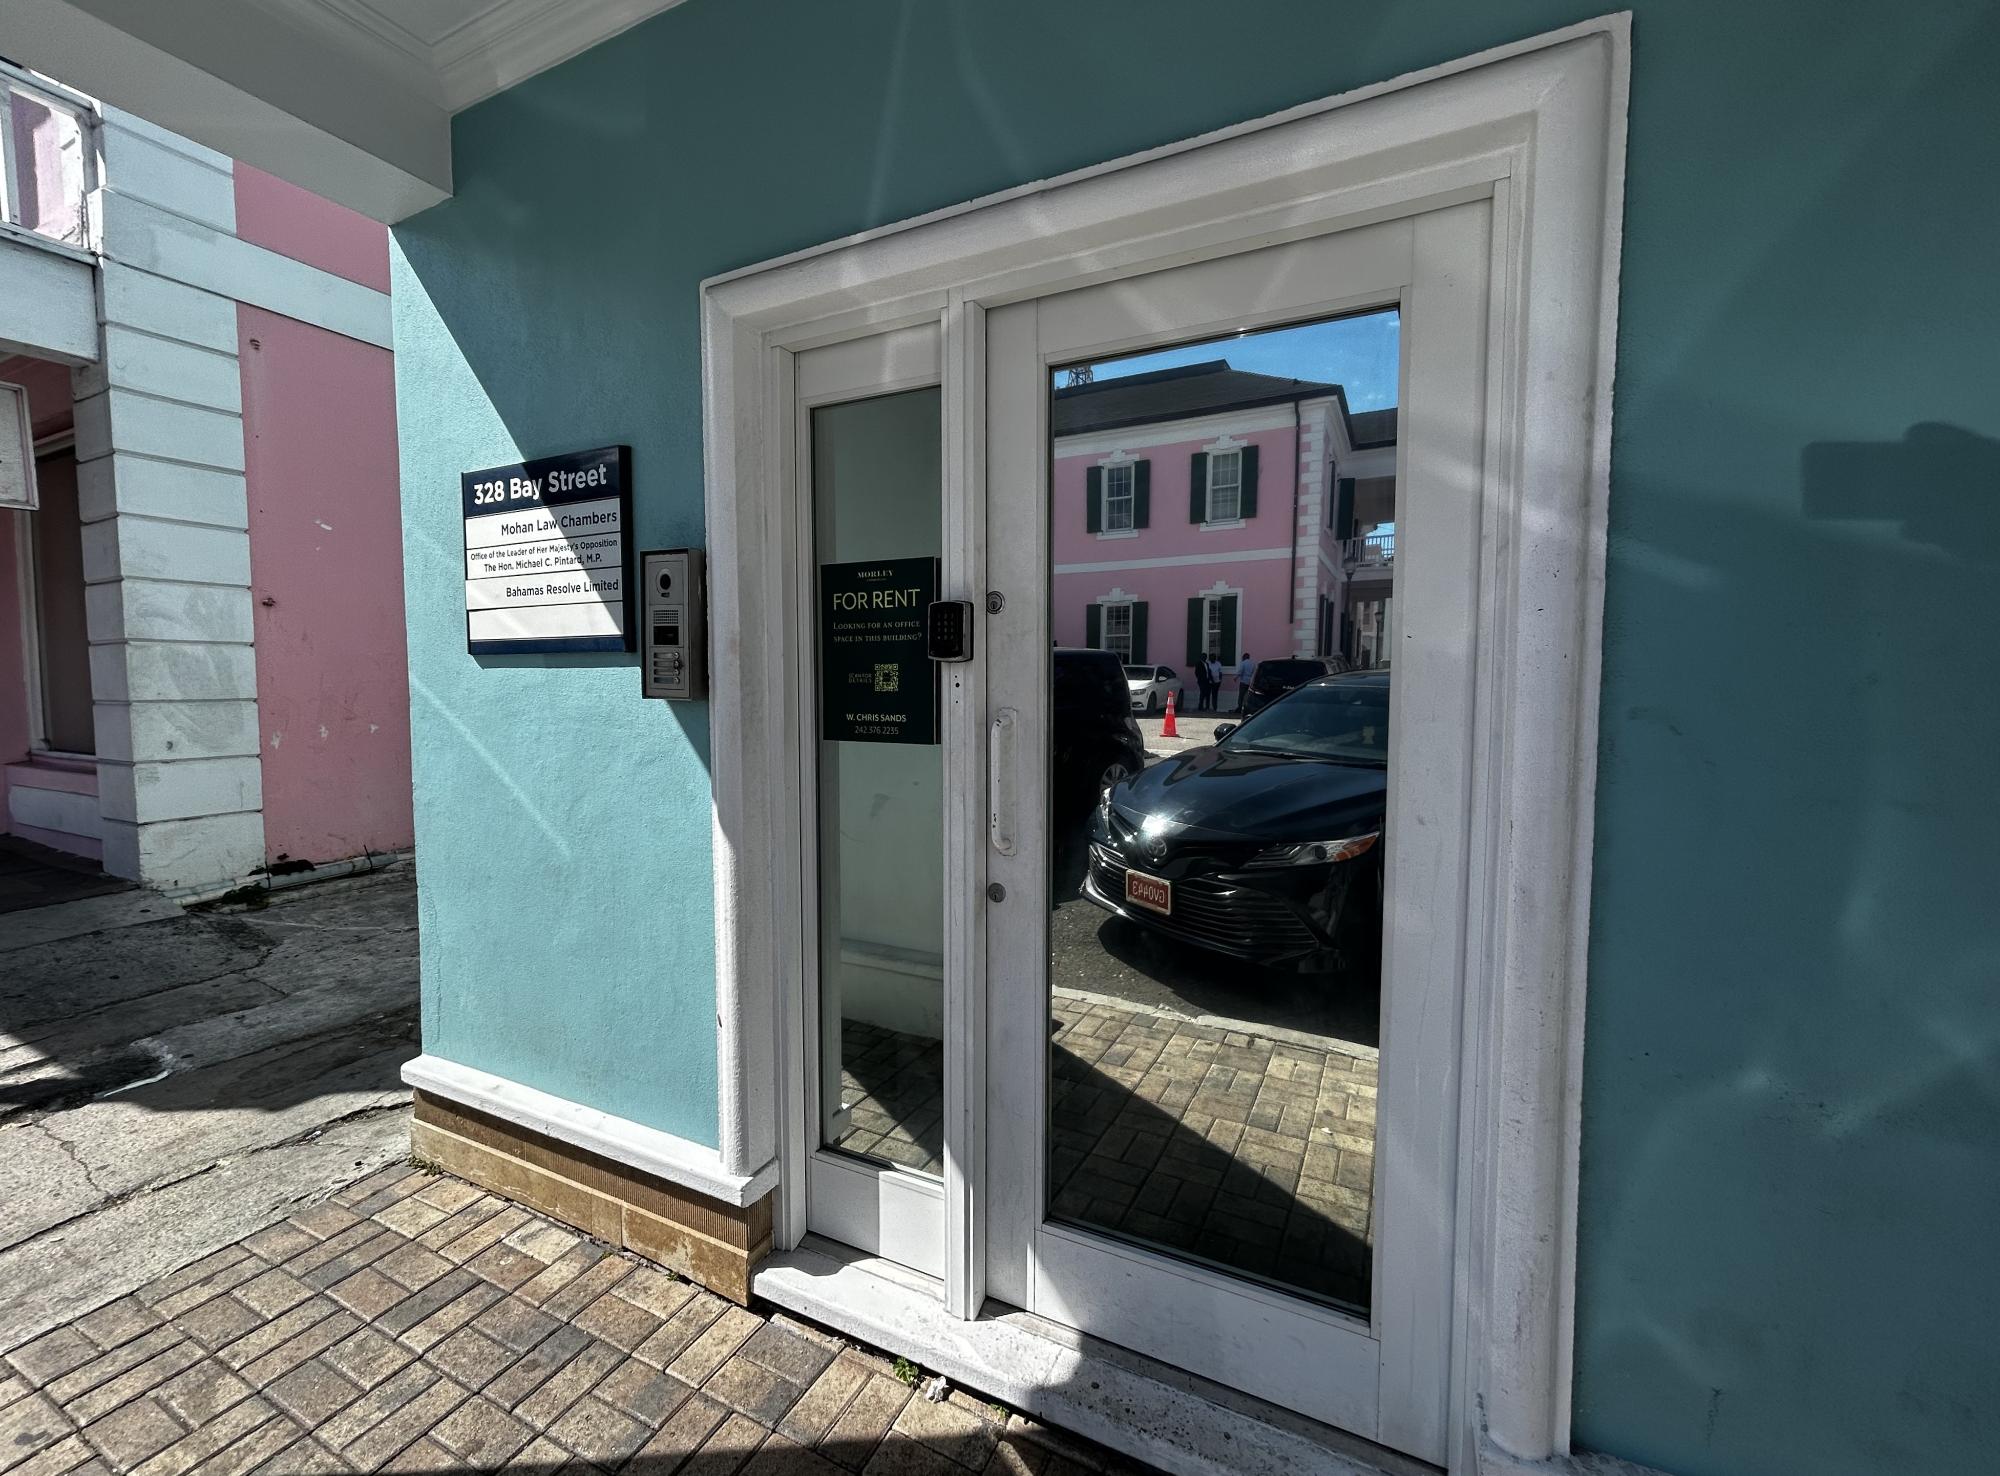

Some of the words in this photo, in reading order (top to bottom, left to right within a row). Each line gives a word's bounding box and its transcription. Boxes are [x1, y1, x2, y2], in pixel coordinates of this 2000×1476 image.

[473, 481, 505, 505] 328
[510, 477, 542, 500] Bay
[548, 463, 607, 493] Street
[501, 519, 534, 536] Mohan
[537, 516, 558, 531] Law
[561, 511, 617, 528] Chambers
[496, 550, 505, 558] the
[506, 548, 527, 557] Leader
[528, 547, 535, 555] of
[536, 546, 548, 554] Her
[549, 542, 579, 552] Majesty's
[580, 539, 618, 550] Opposition
[484, 564, 496, 572] The
[498, 562, 514, 571] Hon.
[515, 559, 543, 570] Michael
[545, 558, 552, 567] C.
[555, 554, 584, 566] Pintard,
[586, 553, 602, 563] M.P.
[857, 569, 894, 579] MORLEY
[506, 582, 544, 598] Bahamas
[546, 579, 581, 595] Resolve
[583, 577, 619, 593] Limited
[833, 591, 868, 611] FOR
[872, 589, 921, 609] RENT
[846, 713, 856, 721] W.
[856, 713, 879, 722] CHRIS
[880, 714, 907, 723] SANDS
